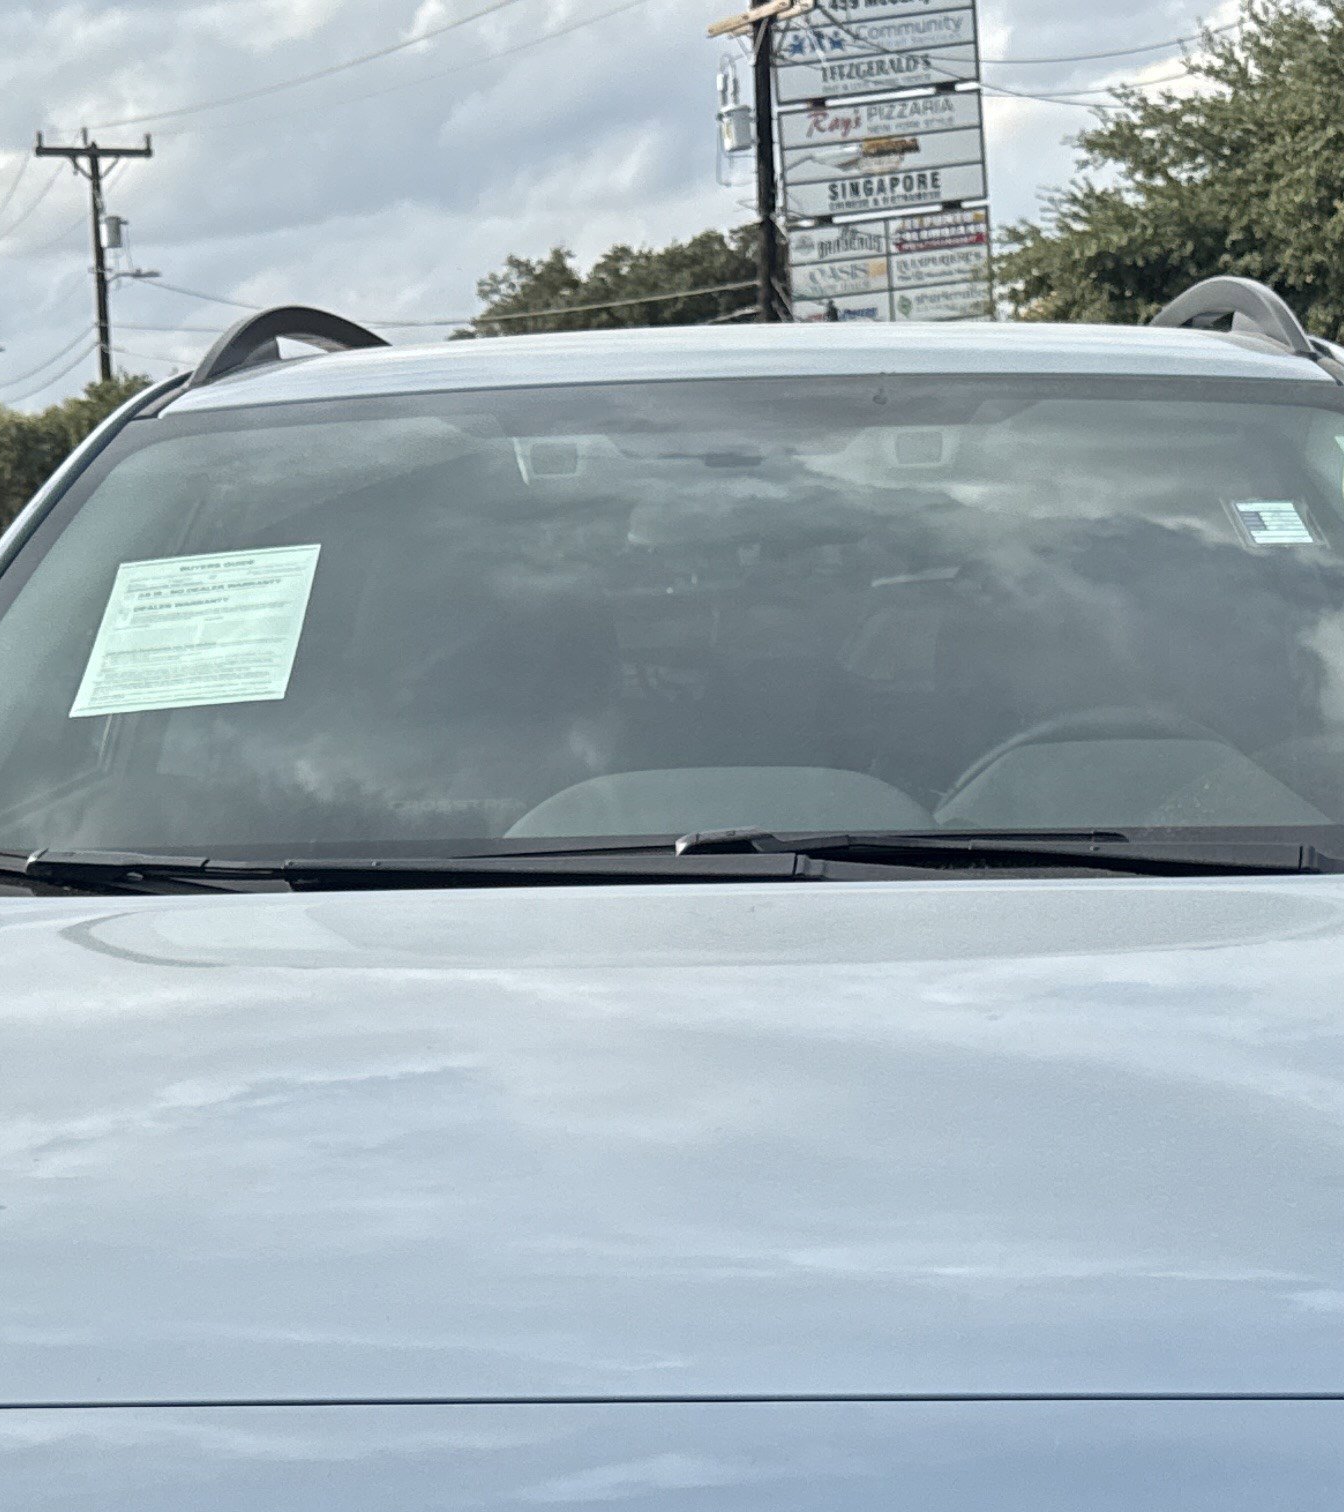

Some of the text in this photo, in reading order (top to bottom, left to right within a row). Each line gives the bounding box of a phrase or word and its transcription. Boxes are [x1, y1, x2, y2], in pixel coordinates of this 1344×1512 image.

[856, 16, 963, 40] Community
[867, 97, 953, 121] PIZZARIA
[828, 171, 941, 201] SINGAPORE
